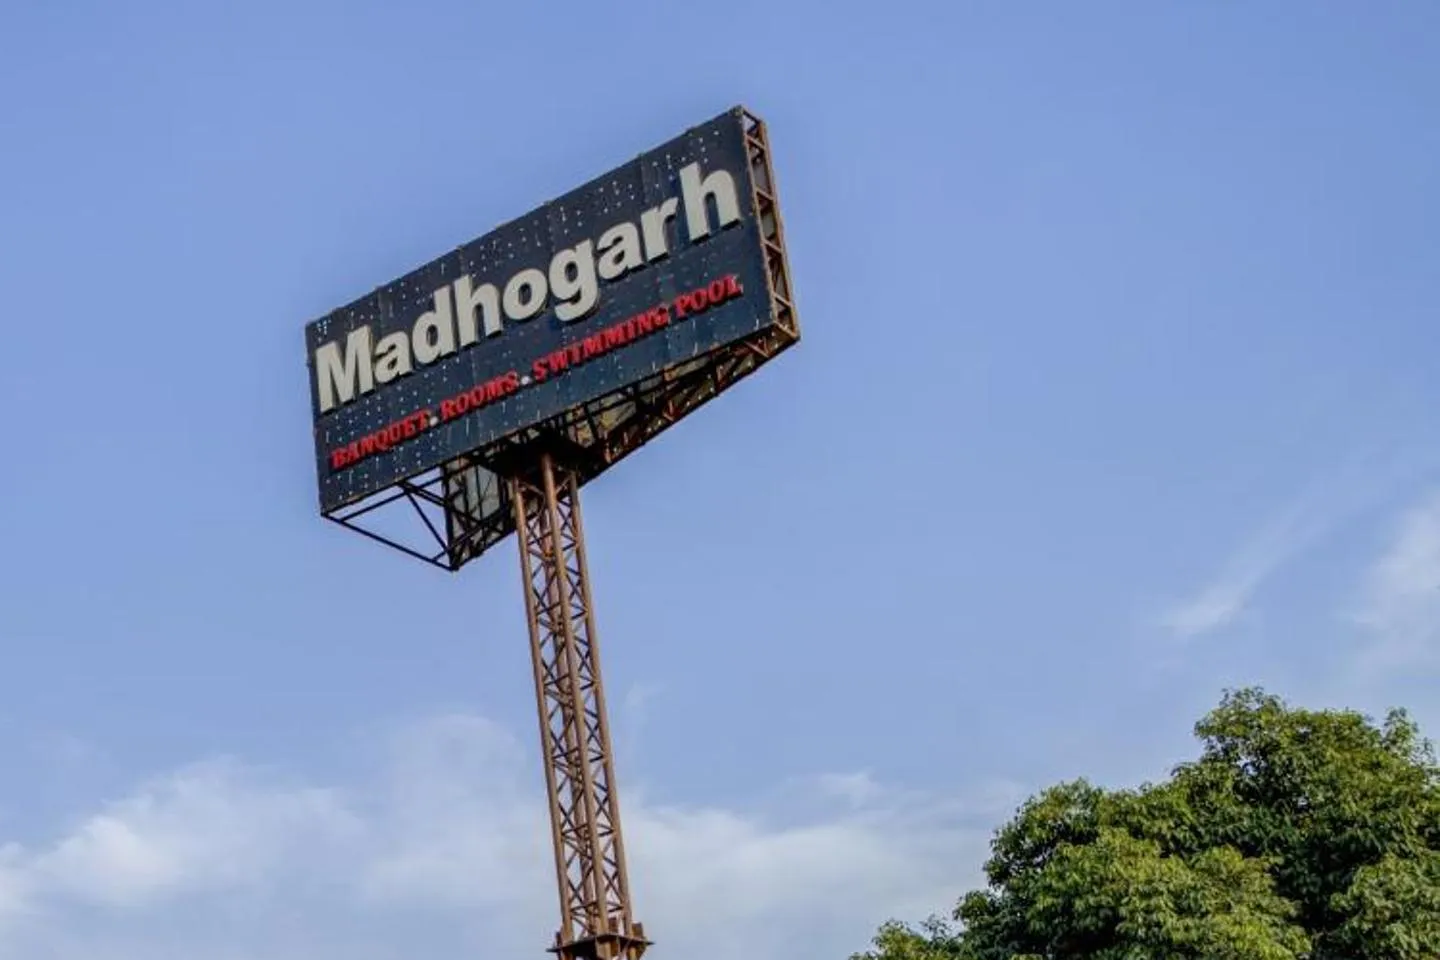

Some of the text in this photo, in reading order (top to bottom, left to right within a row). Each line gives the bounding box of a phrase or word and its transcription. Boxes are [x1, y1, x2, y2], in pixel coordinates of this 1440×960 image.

[315, 161, 741, 415] Madhogarh
[330, 273, 744, 469] BANQUET ROOMS SWIMMING POOL
